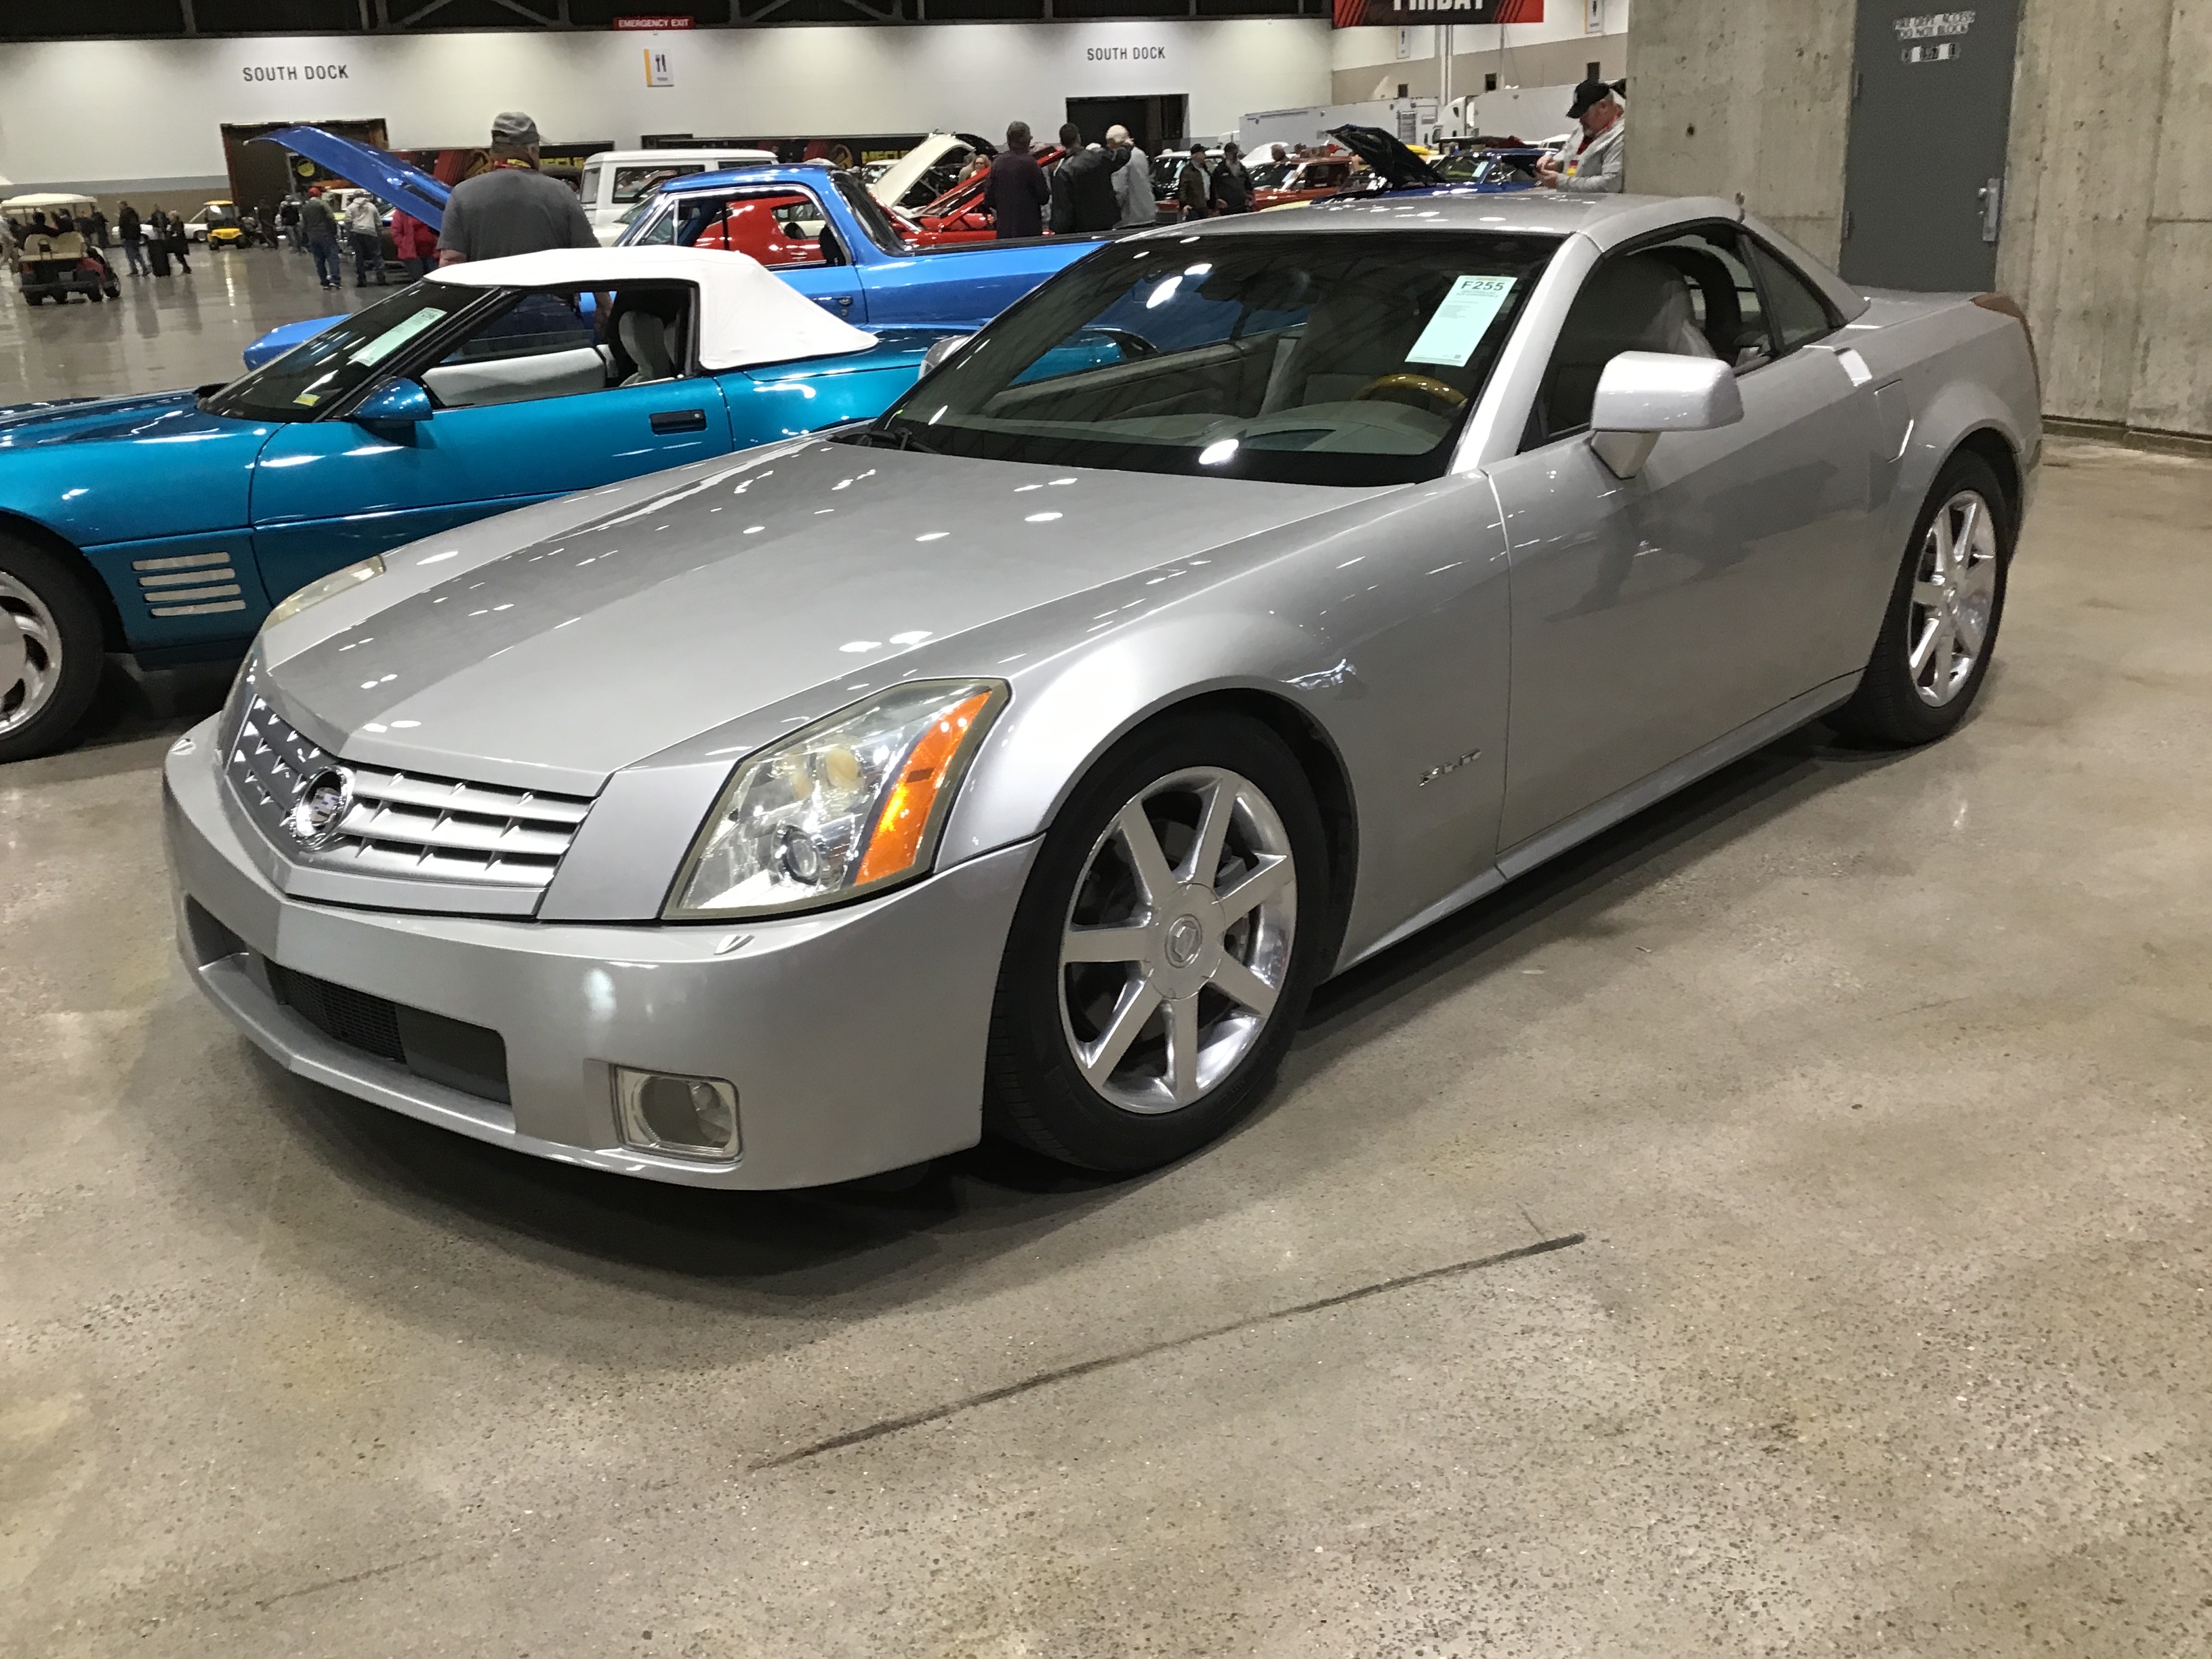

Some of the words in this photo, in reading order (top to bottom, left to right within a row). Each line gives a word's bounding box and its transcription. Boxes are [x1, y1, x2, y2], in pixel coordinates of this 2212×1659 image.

[618, 19, 670, 27] EMERGENCY
[1087, 47, 1128, 60] SOUTH
[1132, 47, 1166, 60] DOCK
[243, 66, 298, 81] SOUTH
[304, 64, 349, 79] DOCK
[1461, 281, 1505, 291] F255
